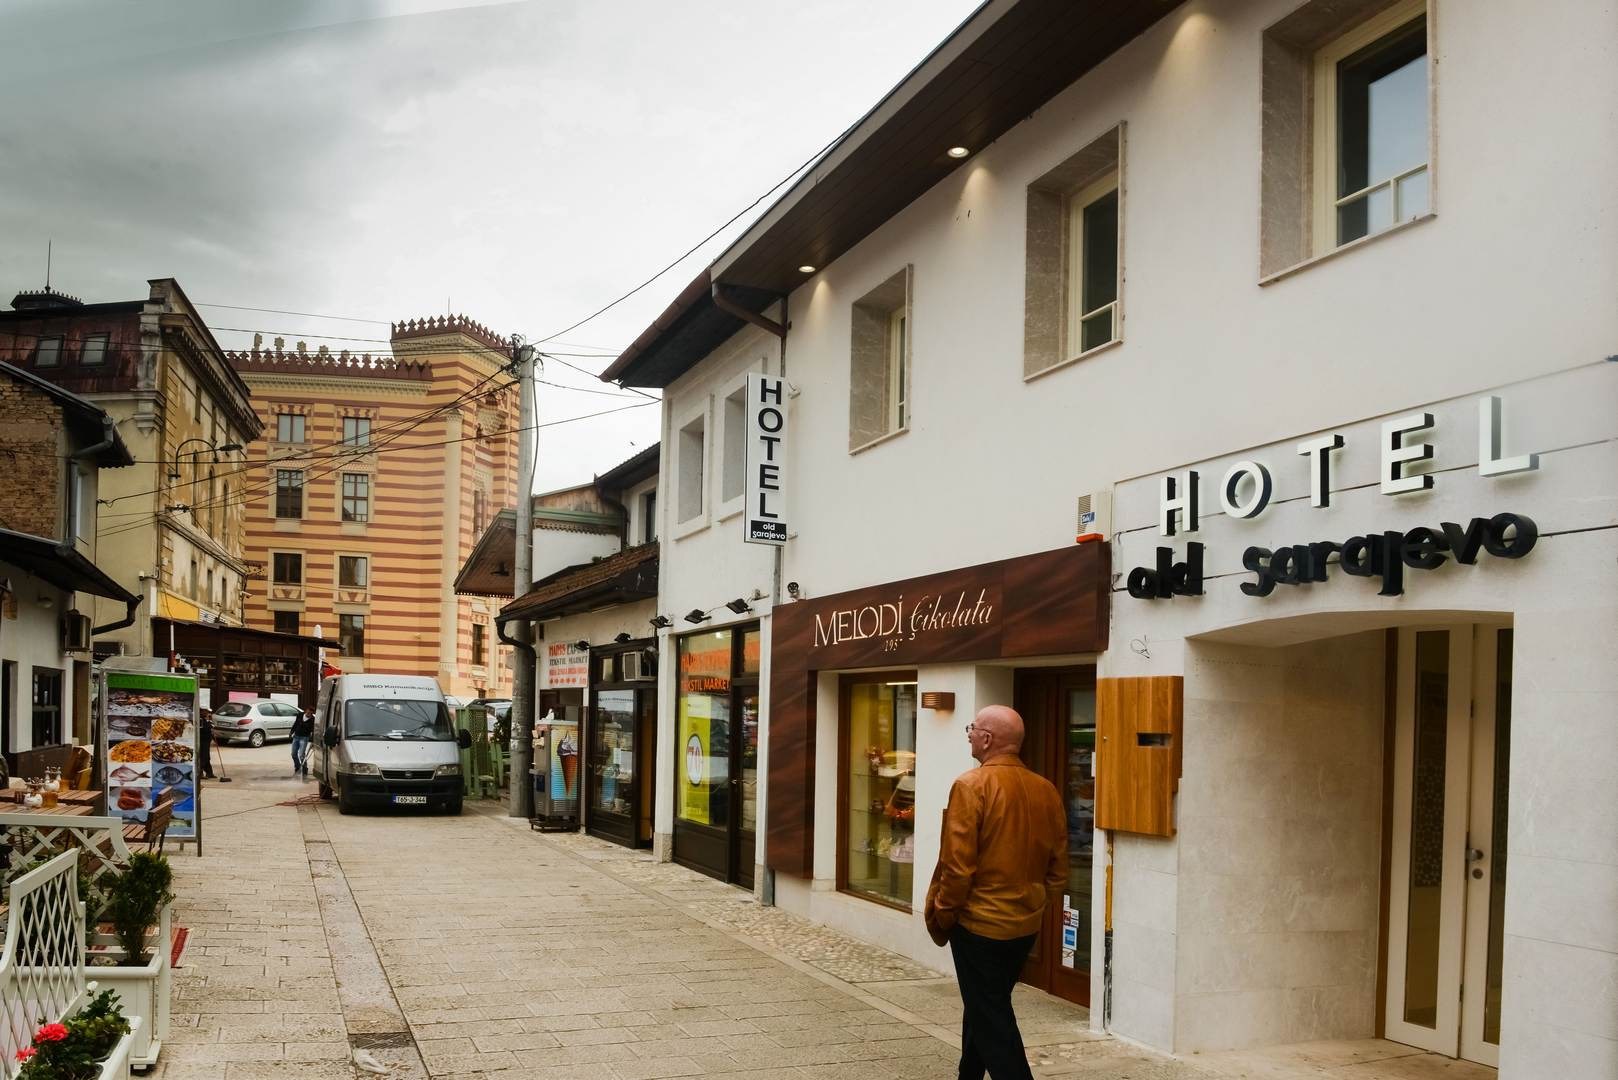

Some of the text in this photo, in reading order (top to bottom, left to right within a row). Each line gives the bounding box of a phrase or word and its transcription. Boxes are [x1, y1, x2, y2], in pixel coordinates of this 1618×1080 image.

[758, 378, 783, 518] HOTEL
[1160, 396, 1539, 536] HOTEL
[752, 528, 785, 540] sarajevo
[762, 522, 776, 530] old
[1127, 512, 1538, 599] old sarajevo
[814, 588, 993, 647] MELODİ Çikolata
